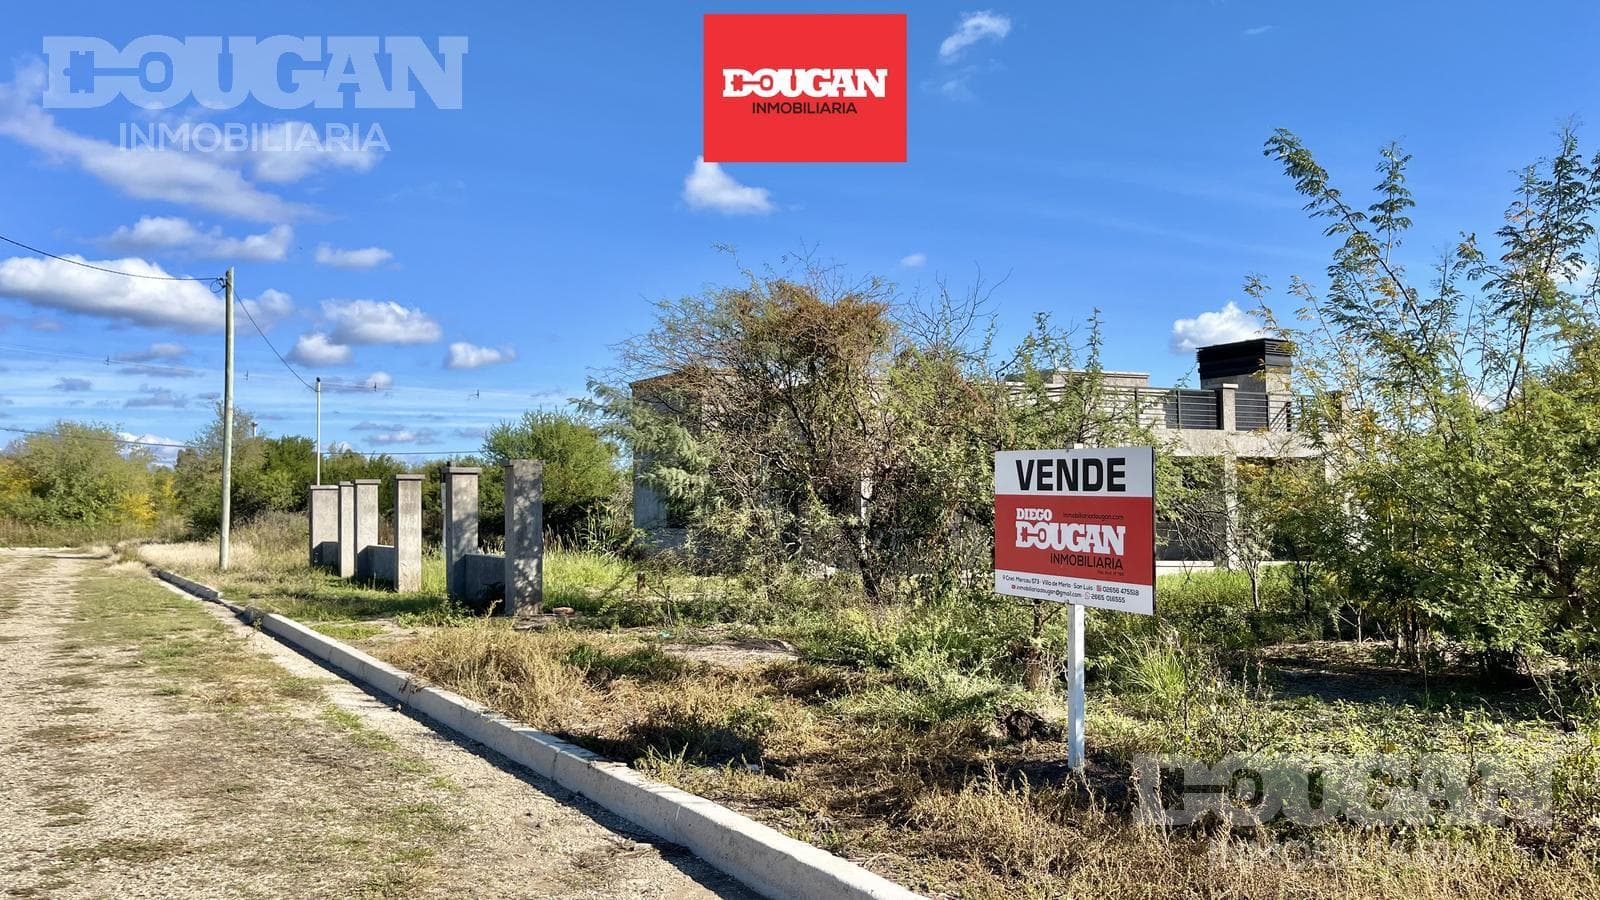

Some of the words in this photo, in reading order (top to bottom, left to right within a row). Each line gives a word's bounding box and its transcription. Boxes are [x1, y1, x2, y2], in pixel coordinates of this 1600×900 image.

[1015, 457, 1127, 493] VENDE
[1015, 507, 1053, 521] DIEGO
[1015, 521, 1126, 556] DOUGAN
[1050, 553, 1124, 570] INMOBILIARIA
